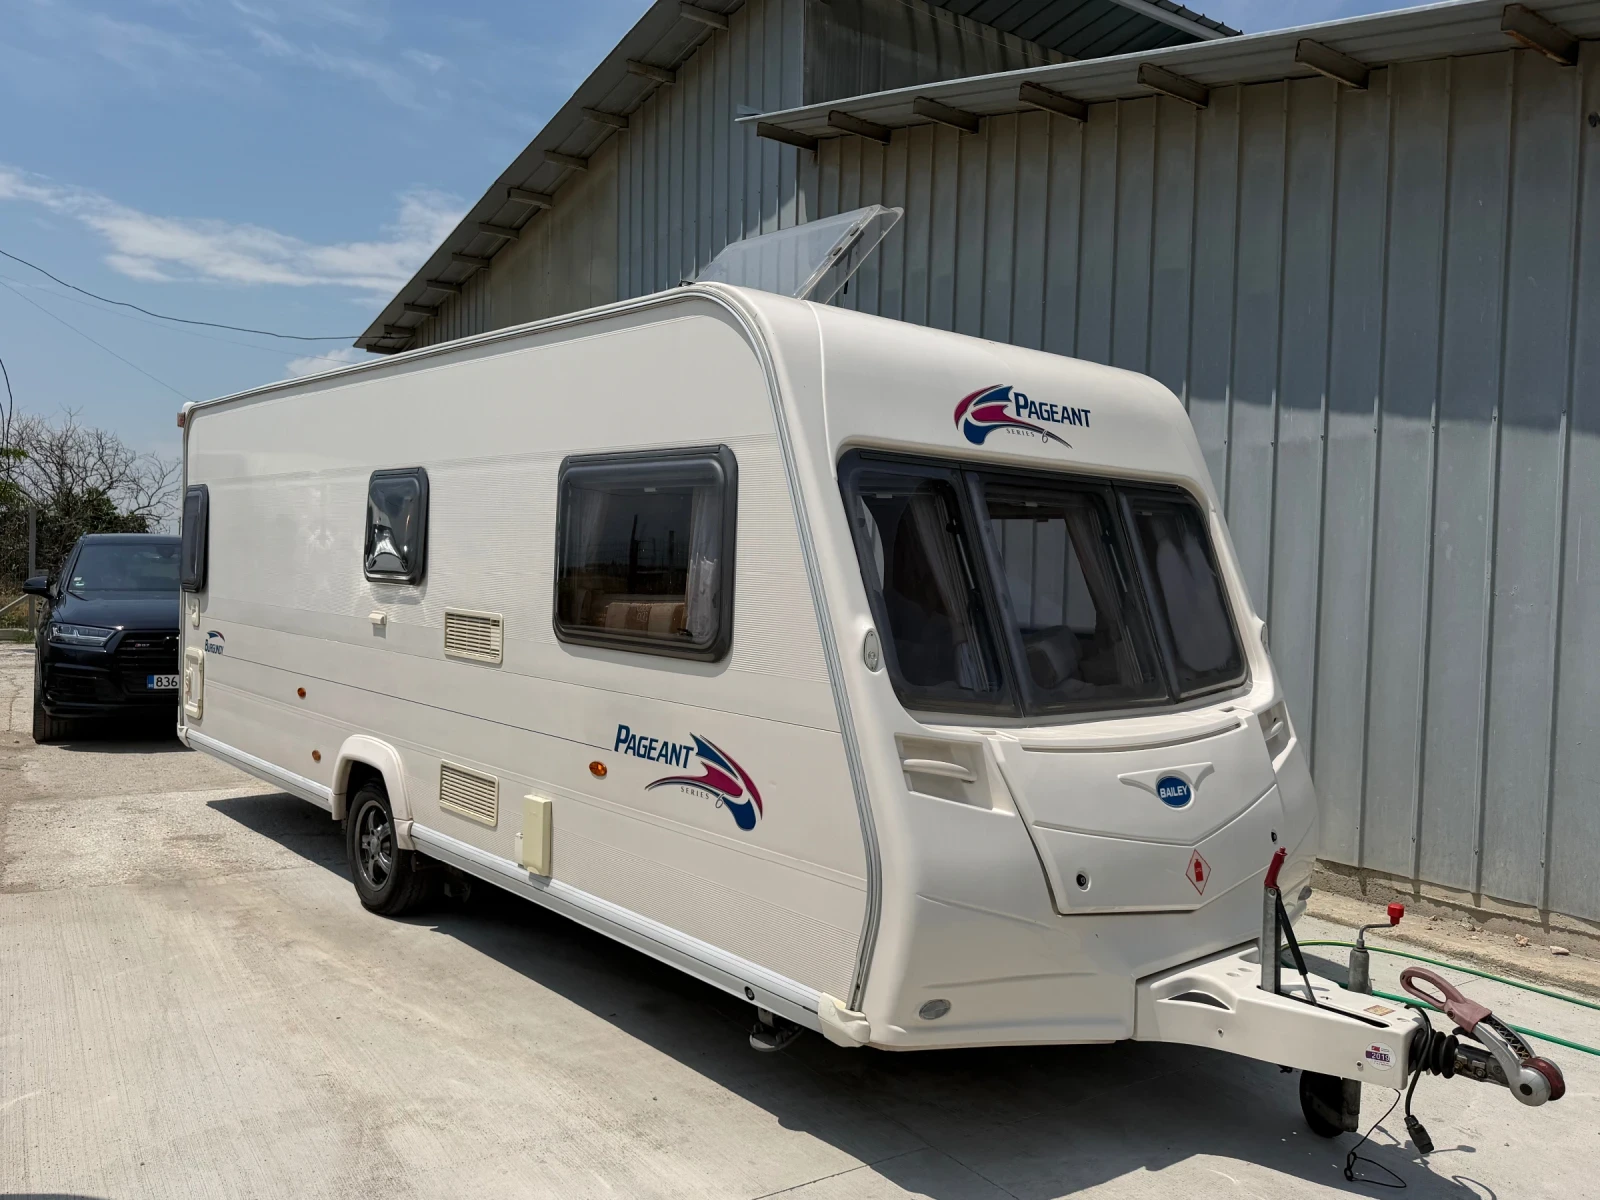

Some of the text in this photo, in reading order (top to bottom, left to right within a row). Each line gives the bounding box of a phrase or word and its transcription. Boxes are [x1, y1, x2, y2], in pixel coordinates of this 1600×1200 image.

[1013, 392, 1091, 428] PAGEANT
[1006, 428, 1049, 444] SERIES 6
[155, 676, 178, 688] 836
[613, 723, 695, 769] PAGEANT
[680, 786, 725, 809] SERIES 6
[1159, 785, 1188, 798] BAILEY
